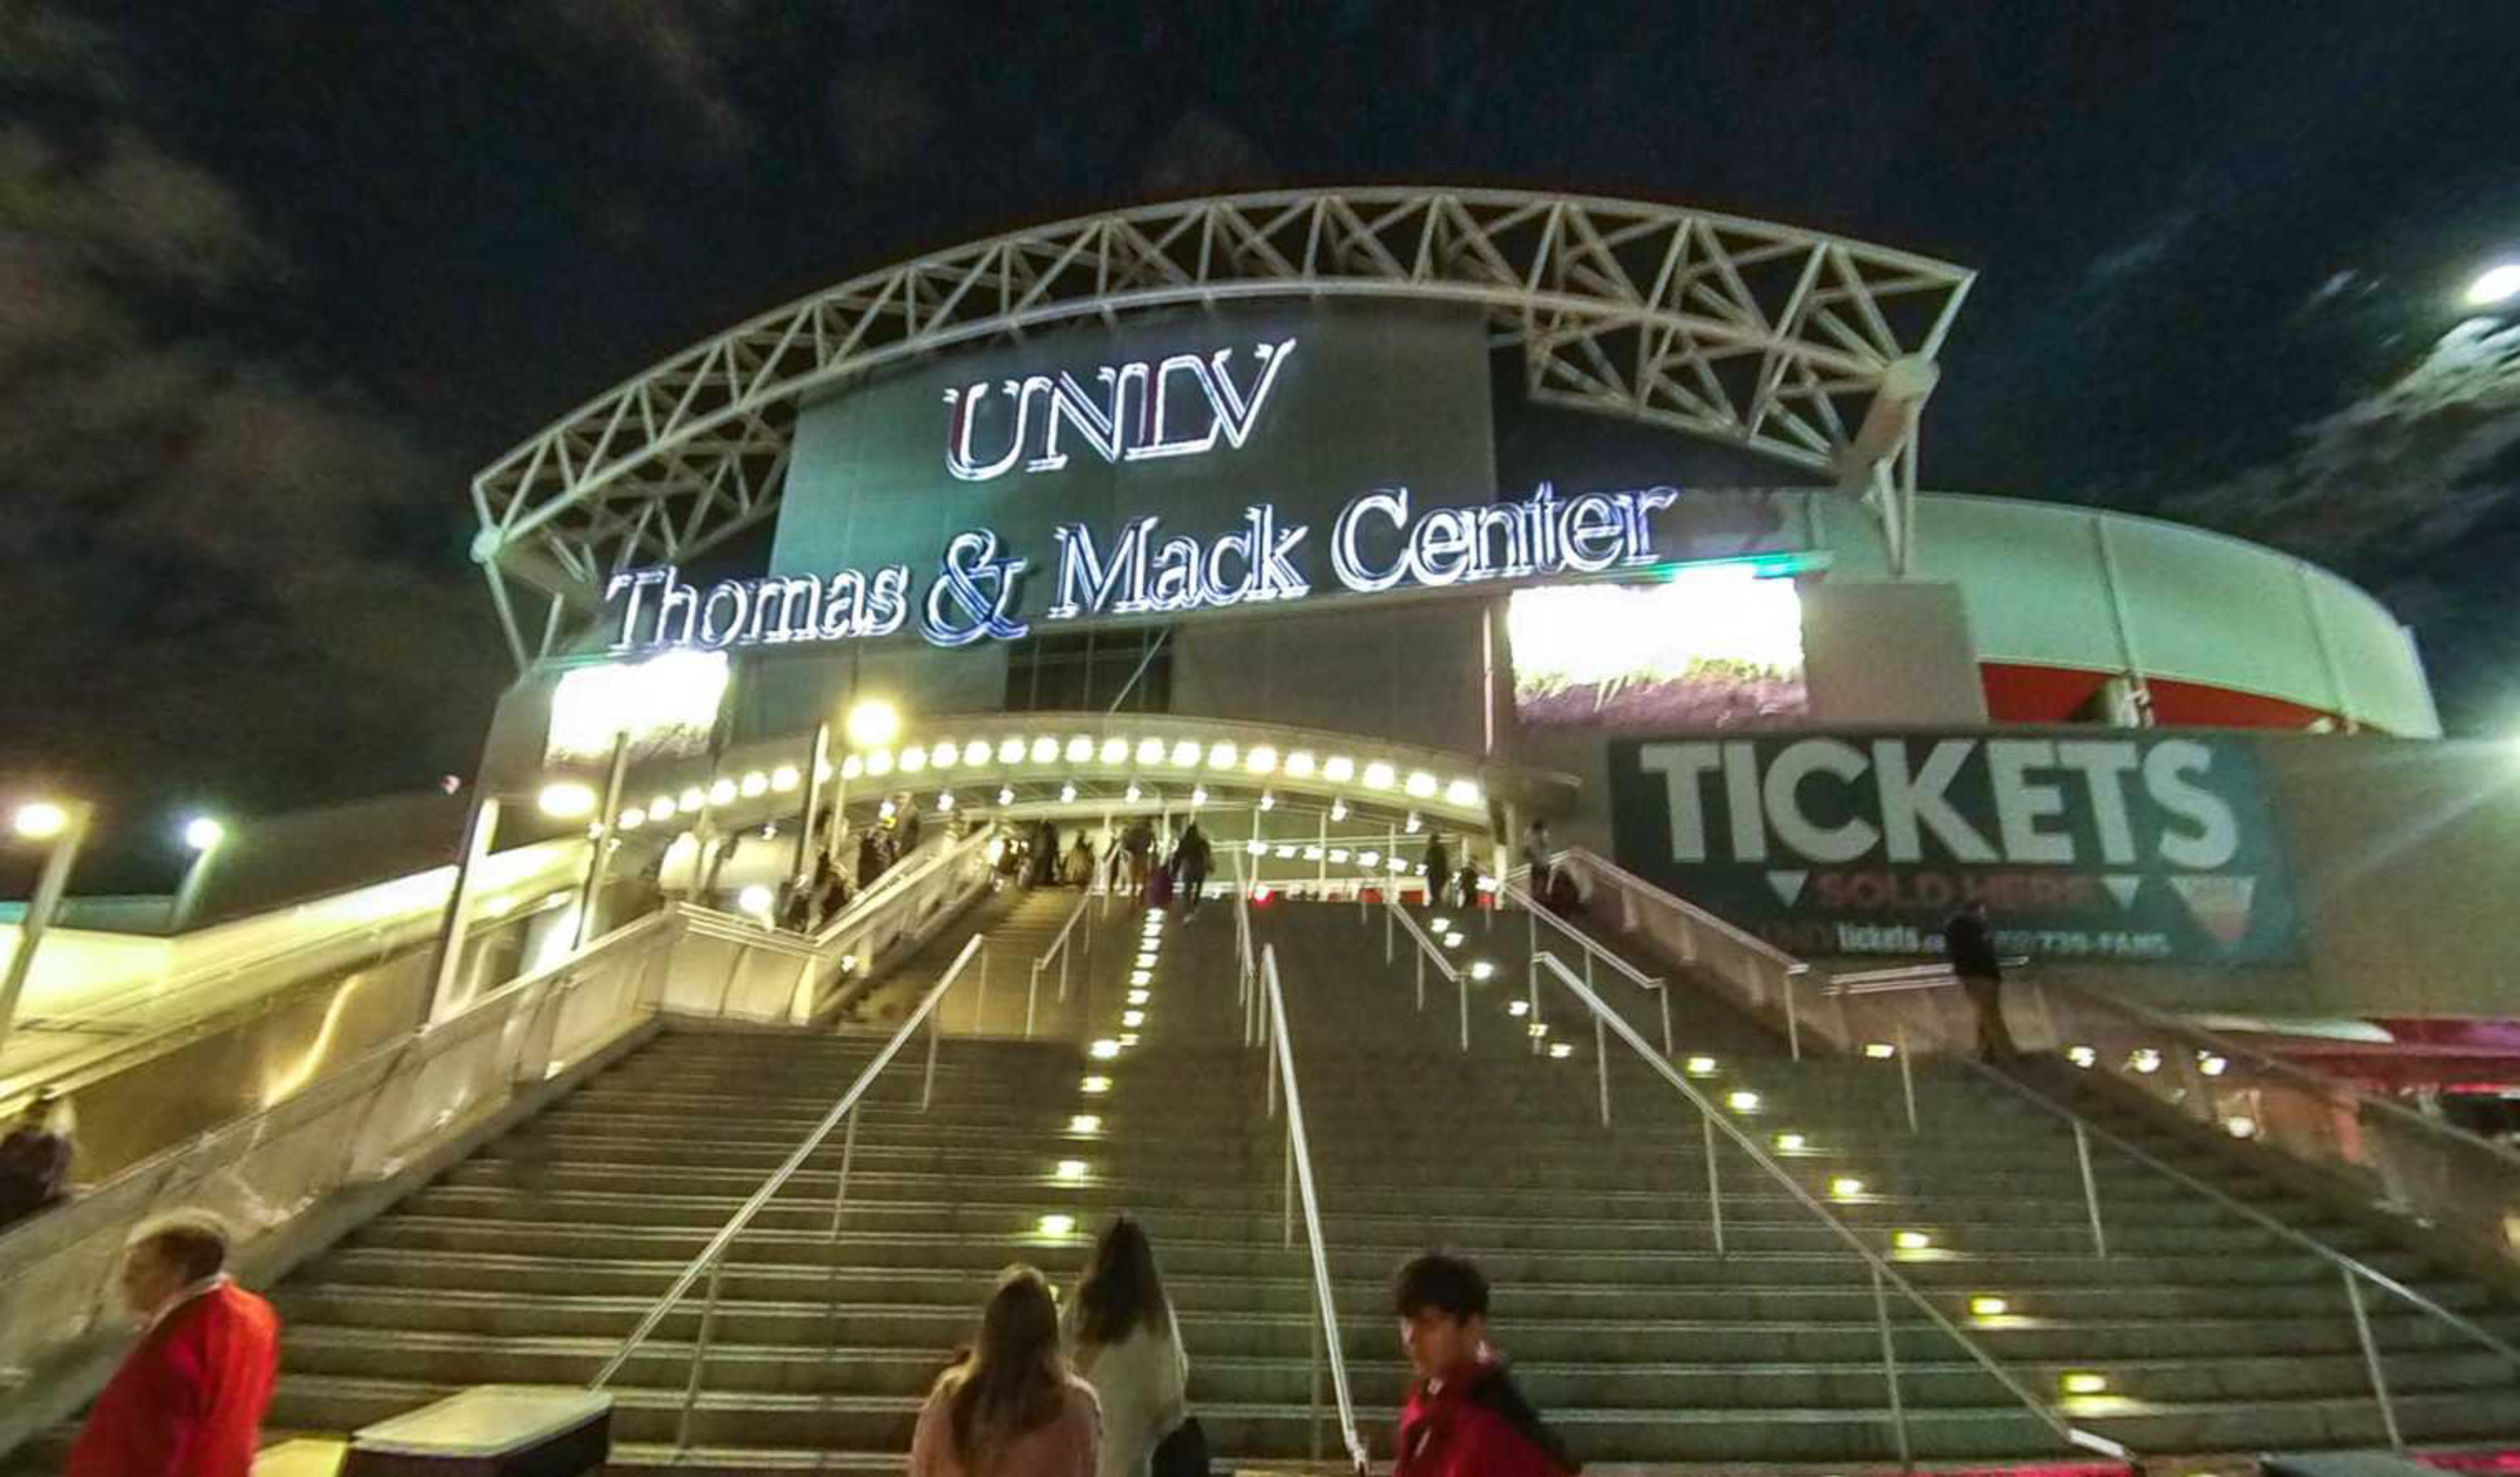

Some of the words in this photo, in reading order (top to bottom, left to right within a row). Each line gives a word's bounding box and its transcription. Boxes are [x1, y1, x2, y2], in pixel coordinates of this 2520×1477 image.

[942, 337, 1297, 481] UNLV
[604, 563, 910, 655] Thomas
[920, 528, 1028, 647] &
[1048, 503, 1311, 620] Mack
[1331, 482, 1679, 592] Center
[1639, 738, 2240, 870] TICKETS
[1813, 870, 1954, 907] SOLD
